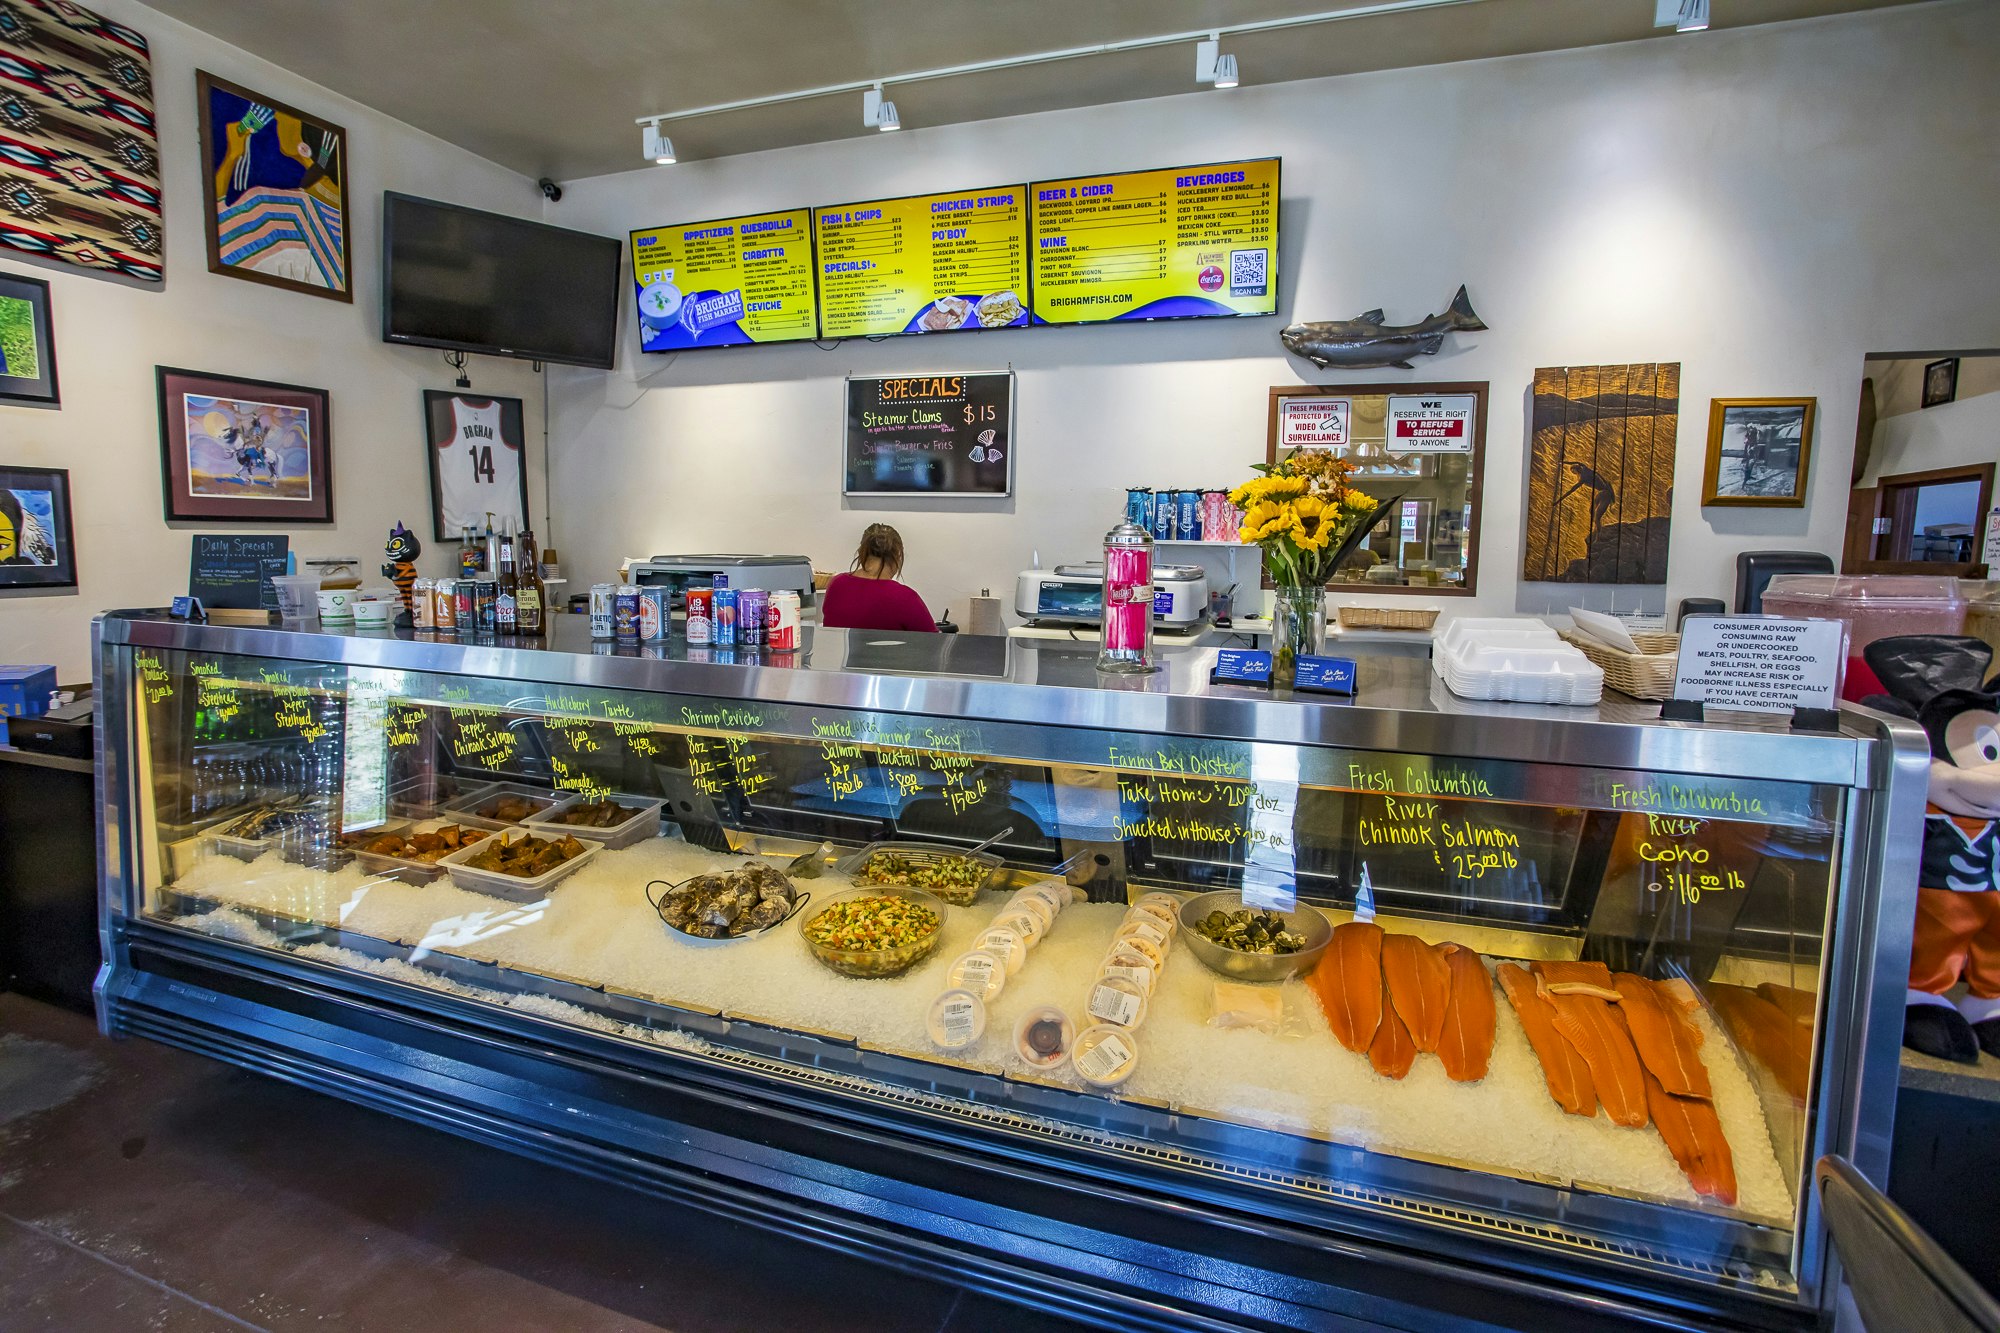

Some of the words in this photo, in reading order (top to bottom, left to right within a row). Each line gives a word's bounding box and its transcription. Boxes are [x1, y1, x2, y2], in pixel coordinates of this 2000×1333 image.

[1176, 171, 1245, 188] BEVERAGES
[1039, 189, 1066, 201] BEER
[1070, 188, 1077, 198] &
[1082, 184, 1113, 197] CIDER
[1178, 187, 1219, 196] HUCKLEBERRY
[1221, 184, 1254, 192] LEMONADE
[931, 199, 973, 213] CHICKEN
[977, 195, 1014, 208] STRIPS
[1178, 196, 1219, 204] HUCKLEBERRY
[822, 214, 842, 224] FISH
[845, 213, 851, 222] &
[855, 209, 882, 221] CHIPS
[684, 226, 733, 240] APPETIZERS
[741, 219, 792, 233] QUESADILLA
[932, 228, 966, 241] PO'BOY
[637, 236, 657, 247] SOUP
[1040, 237, 1066, 248] WINE
[1177, 239, 1209, 247] SPARKLING
[743, 248, 784, 260] CIABATTA
[1040, 247, 1070, 255] SAUVIGNON
[825, 260, 870, 273] SPECIALS!
[1041, 279, 1078, 287] HUCKLEBERRY
[695, 292, 740, 315] BRIGHAM
[747, 301, 782, 312] CEVICHE
[1051, 294, 1132, 306] BRIGHAMFISH.COM
[698, 313, 713, 323] FISH
[714, 304, 741, 318] MARKET
[882, 378, 961, 399] SPECIALS
[863, 412, 908, 428] Steamer
[912, 409, 942, 423] Clams
[934, 440, 953, 450] Fries
[1288, 433, 1340, 442] SURVEILLANCE
[469, 445, 495, 483] 14
[201, 538, 228, 558] Daily
[234, 539, 274, 556] Specials
[693, 598, 702, 606] 19
[1763, 625, 1808, 633] ADVISORY
[1732, 643, 1798, 652] UNDERCOOKED
[1710, 661, 1757, 669] SHELLFISH,
[1772, 654, 1817, 663] SEAFOOD,
[190, 662, 222, 676] Smoked
[1724, 671, 1766, 679] INCREASE
[1681, 678, 1733, 686] FOODBORNE
[1735, 681, 1771, 689] ILLNESS
[1774, 683, 1828, 692] ESPECIALLY
[1704, 698, 1741, 706] MEDICAL
[1744, 700, 1797, 709] CONDITIONS
[1760, 692, 1798, 700] CERTAIN
[545, 695, 590, 715] Huckleberry
[601, 700, 634, 718] Turtle
[682, 707, 719, 730] Shrimp
[722, 708, 764, 727] Ceviche
[811, 717, 856, 737] Smoked
[486, 731, 517, 748] Salmon
[925, 728, 961, 753] Spicy
[821, 740, 862, 760] Salmon
[876, 749, 920, 767] Cocktail
[928, 751, 974, 770] Salmon
[1109, 747, 1155, 782] Fanny
[1157, 750, 1186, 783] Bay
[830, 761, 850, 780] Dip
[943, 768, 964, 790] Dip
[1349, 764, 1395, 793] Fresh
[1406, 766, 1493, 797] Columbia
[1116, 782, 1155, 803] Take
[1255, 796, 1284, 812] doz
[1611, 784, 1662, 808] Fresh
[1671, 785, 1767, 816] Columbia
[1385, 795, 1439, 821] River
[1113, 816, 1176, 841] Shucked
[1646, 812, 1701, 836] River
[1360, 818, 1436, 846] Chinook
[1441, 821, 1520, 848] Salmon
[1502, 851, 1518, 869] lb
[1639, 842, 1709, 863] Coho
[1728, 871, 1745, 889] lb
